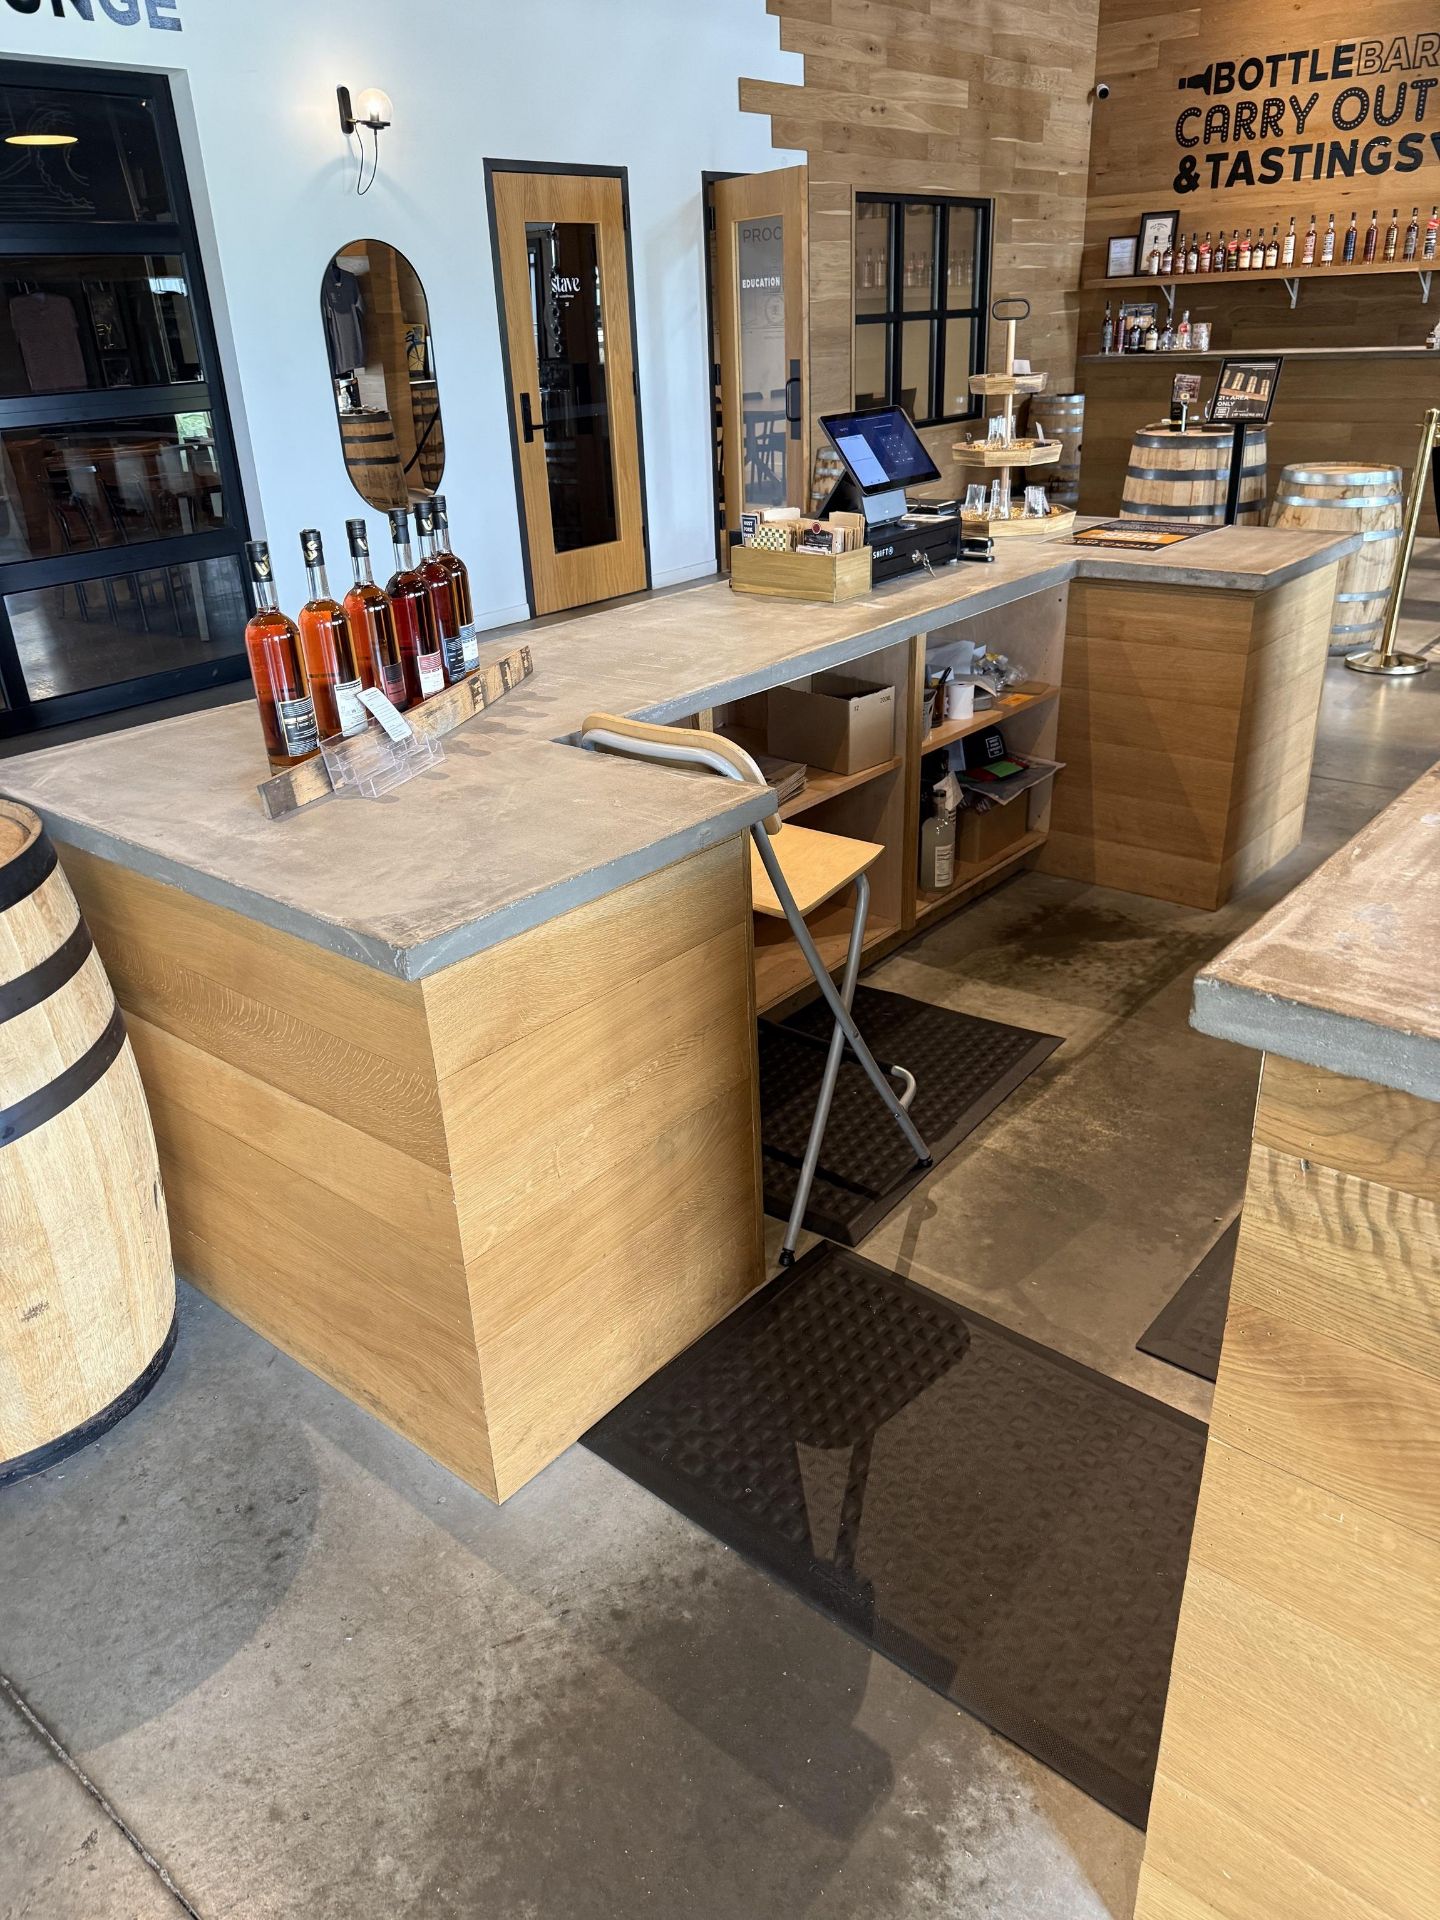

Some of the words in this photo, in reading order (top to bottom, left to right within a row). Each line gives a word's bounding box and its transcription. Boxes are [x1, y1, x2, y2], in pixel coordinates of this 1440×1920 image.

[1175, 92, 1319, 148] CARRY
[1332, 78, 1439, 130] OUT
[551, 274, 581, 293] stave
[742, 277, 781, 288] EDUCATION
